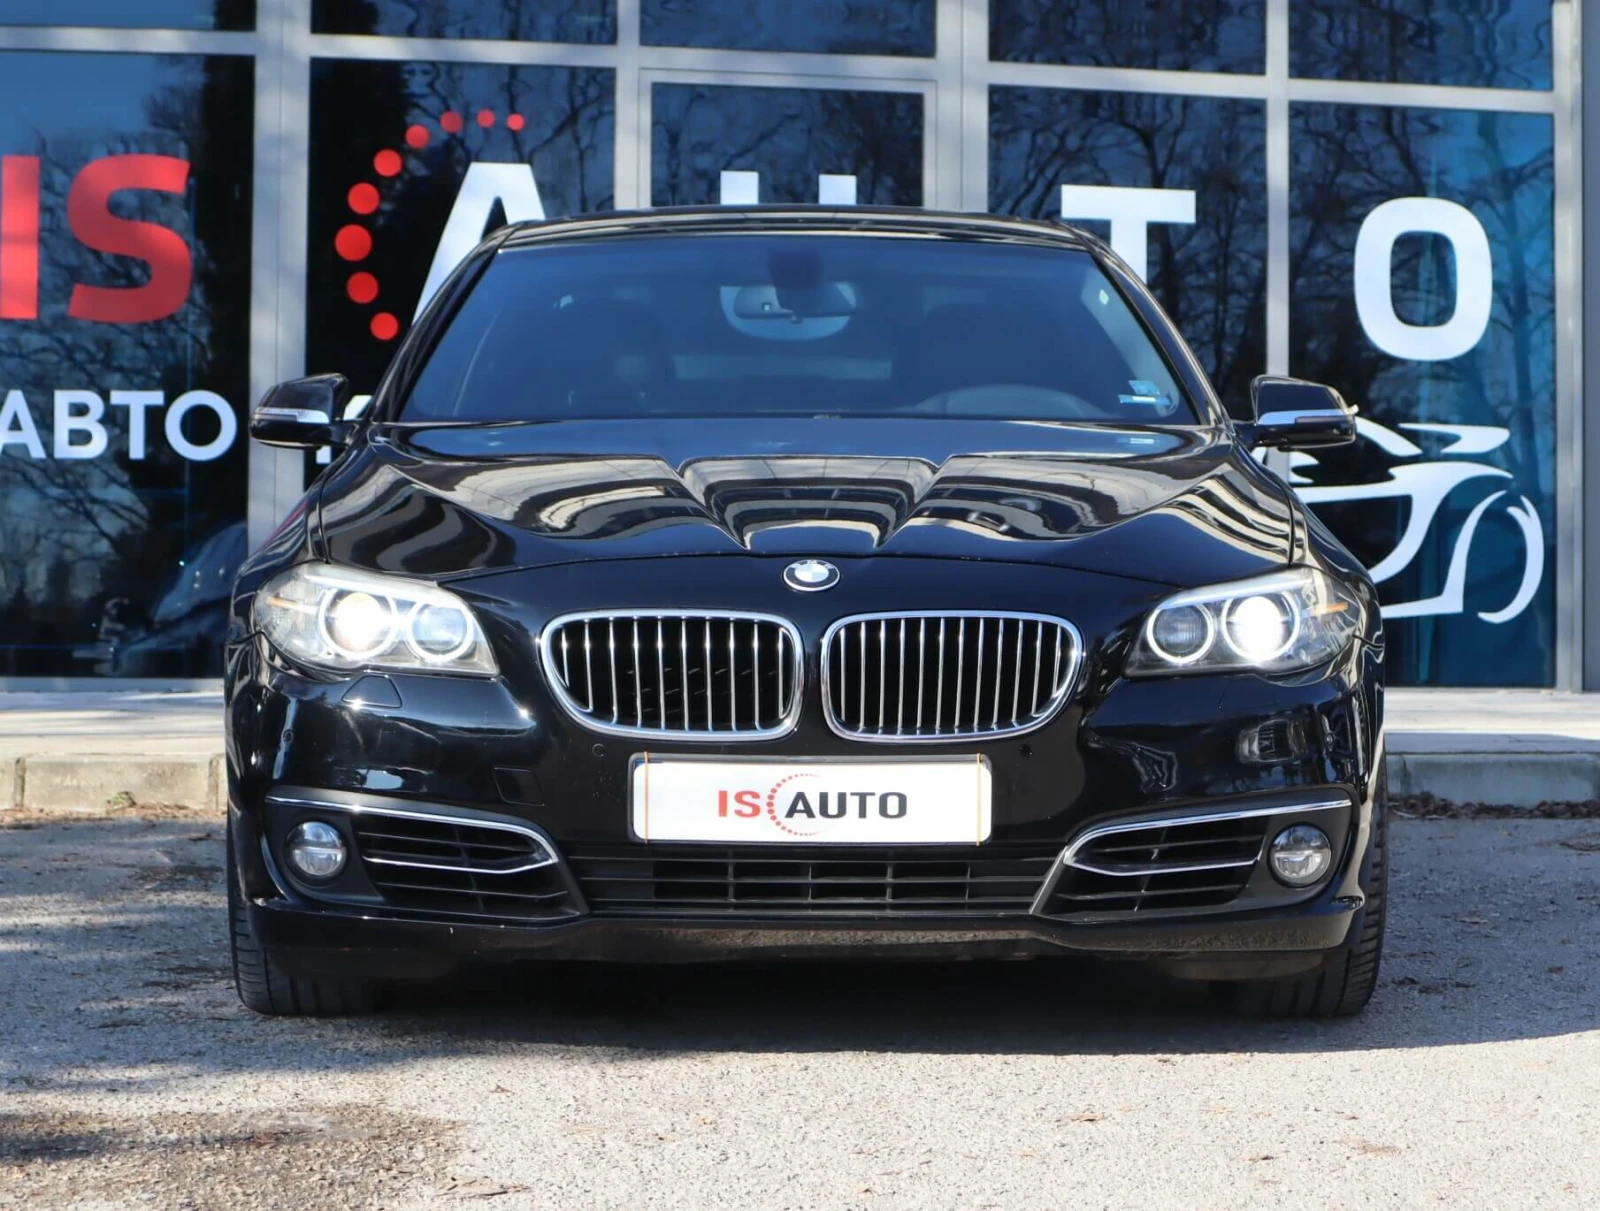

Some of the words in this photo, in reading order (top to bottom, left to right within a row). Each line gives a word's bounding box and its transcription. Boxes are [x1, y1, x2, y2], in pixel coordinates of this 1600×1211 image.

[0, 154, 192, 324] IS
[411, 161, 1493, 362] ATO
[718, 790, 761, 818] IS
[784, 791, 908, 819] AUTO
